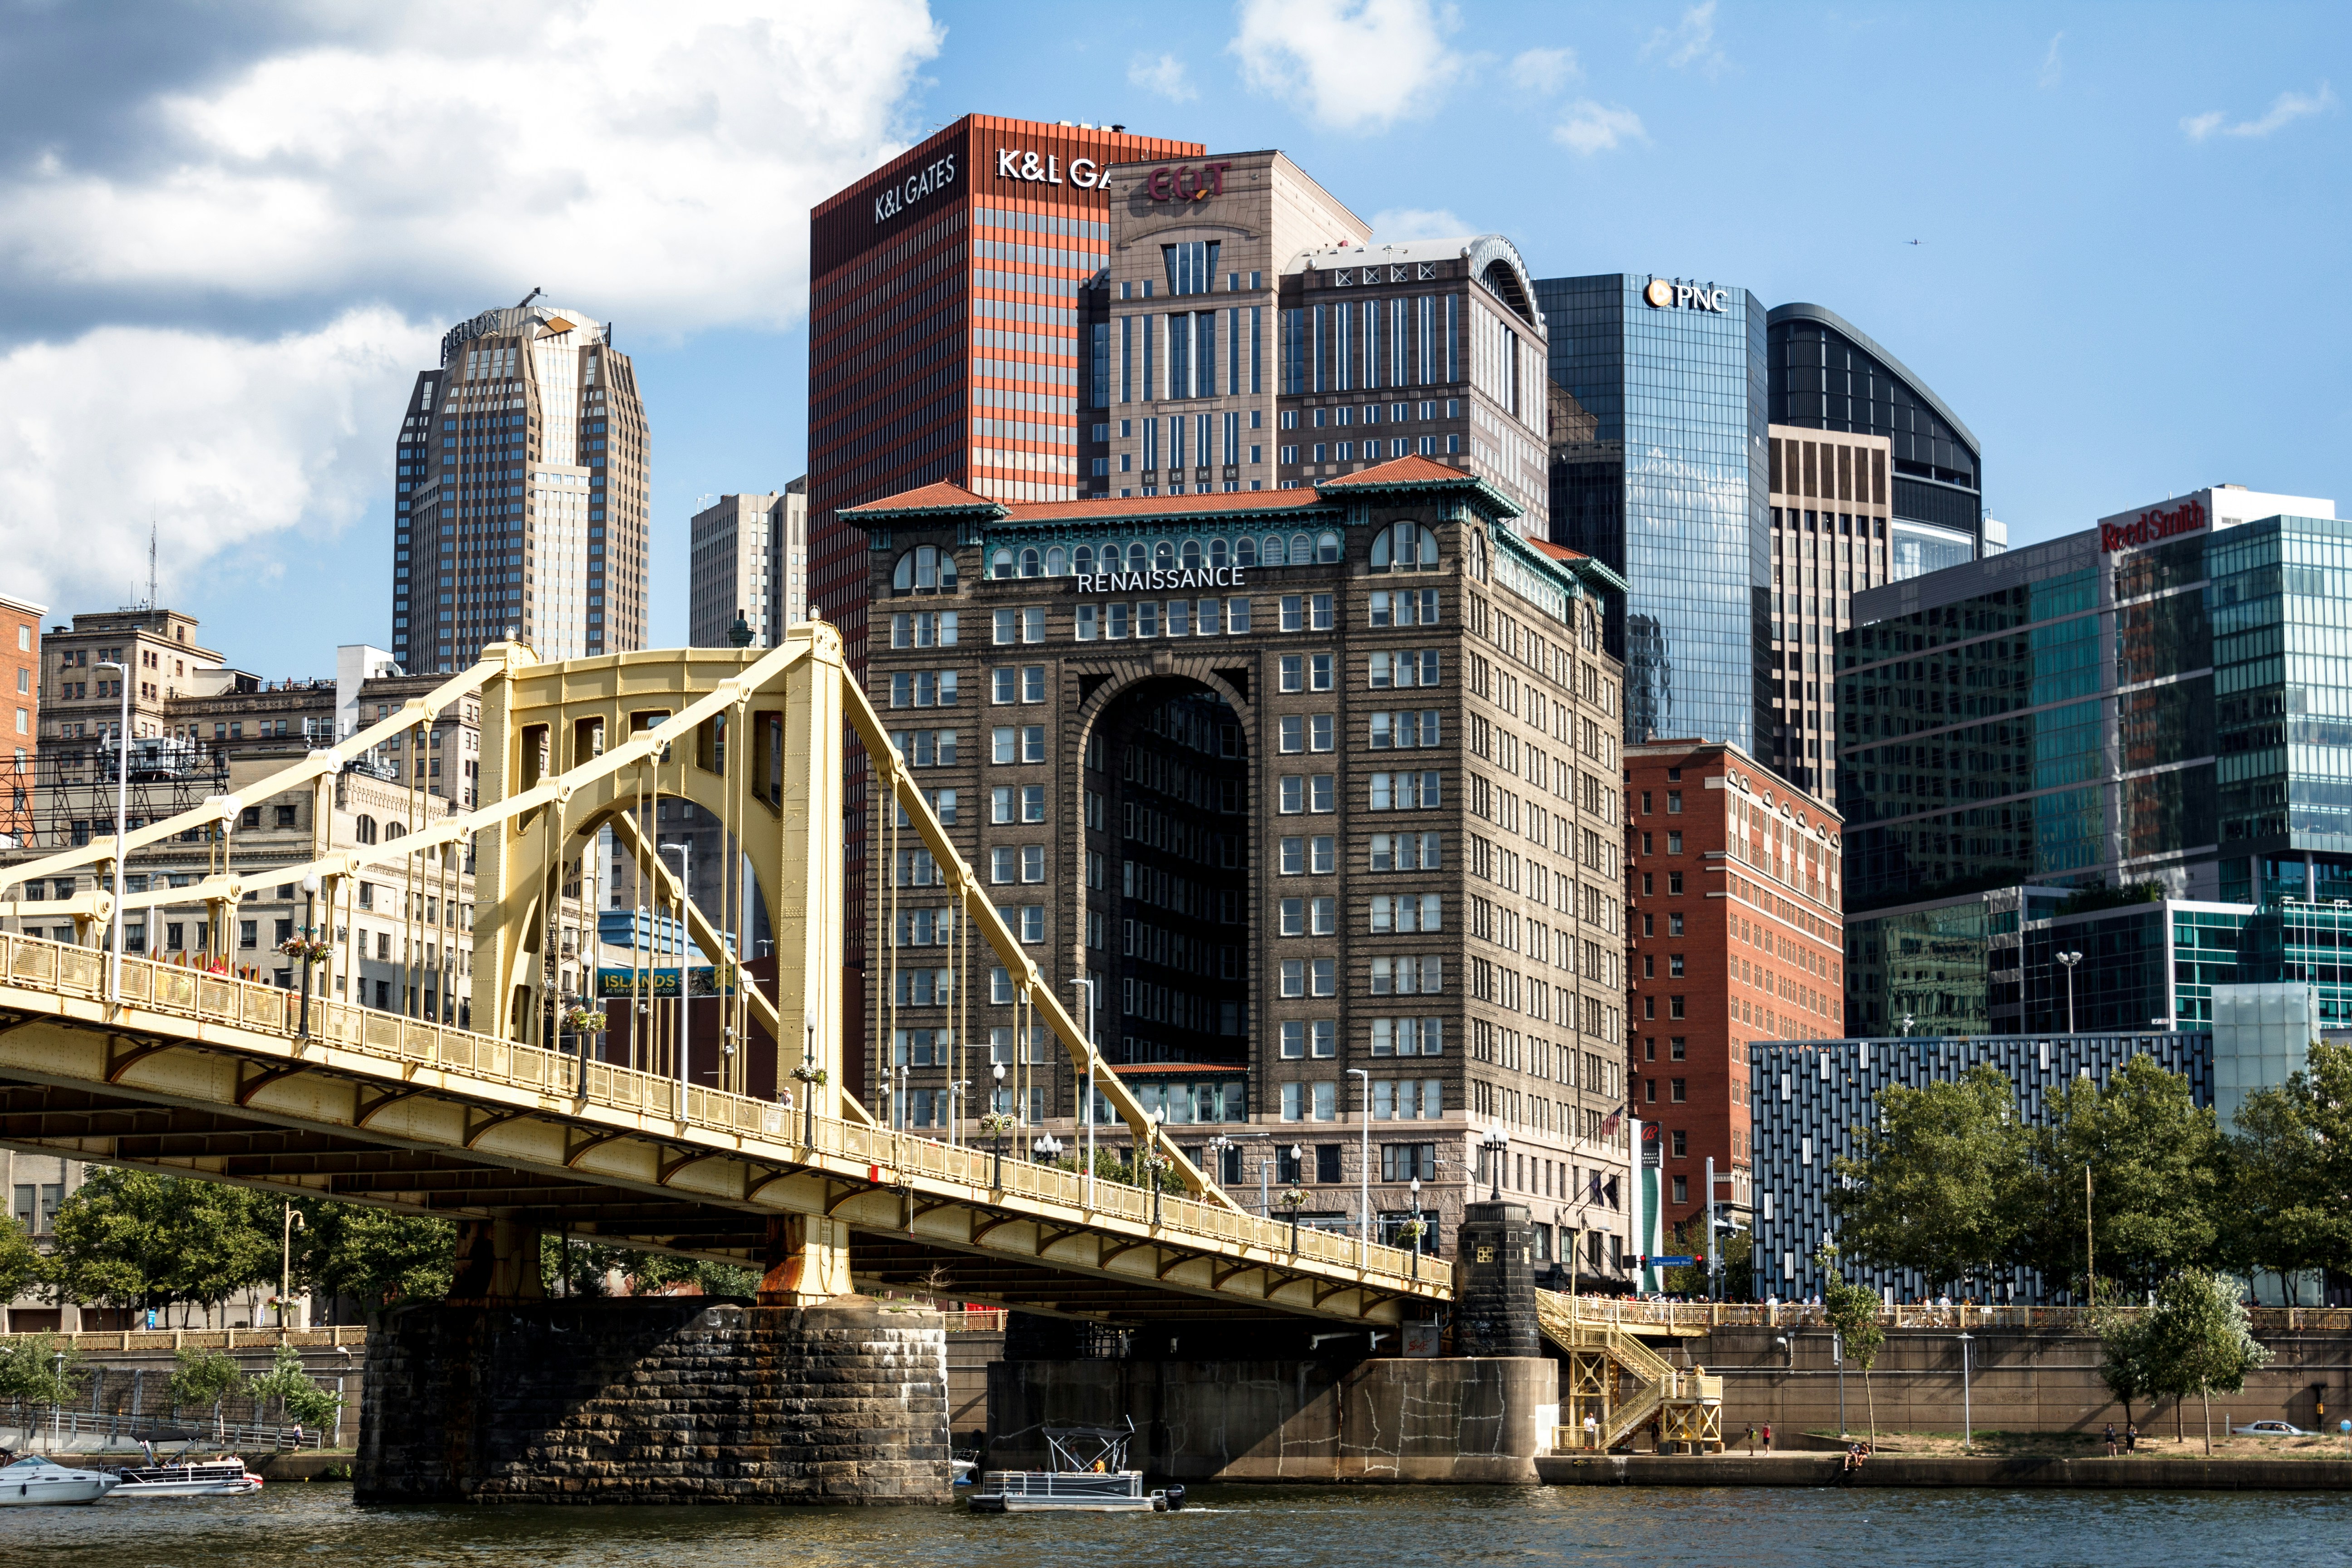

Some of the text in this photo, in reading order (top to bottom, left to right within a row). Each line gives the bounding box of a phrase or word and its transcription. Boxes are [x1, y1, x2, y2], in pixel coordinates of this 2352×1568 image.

[1000, 148, 1062, 183] K&L
[1148, 162, 1231, 200] EQT
[876, 153, 954, 224] K&L GATES
[1675, 284, 1728, 312] PNC
[2101, 500, 2205, 553] Reed Smith
[1078, 566, 1245, 593] RENAISSANCE
